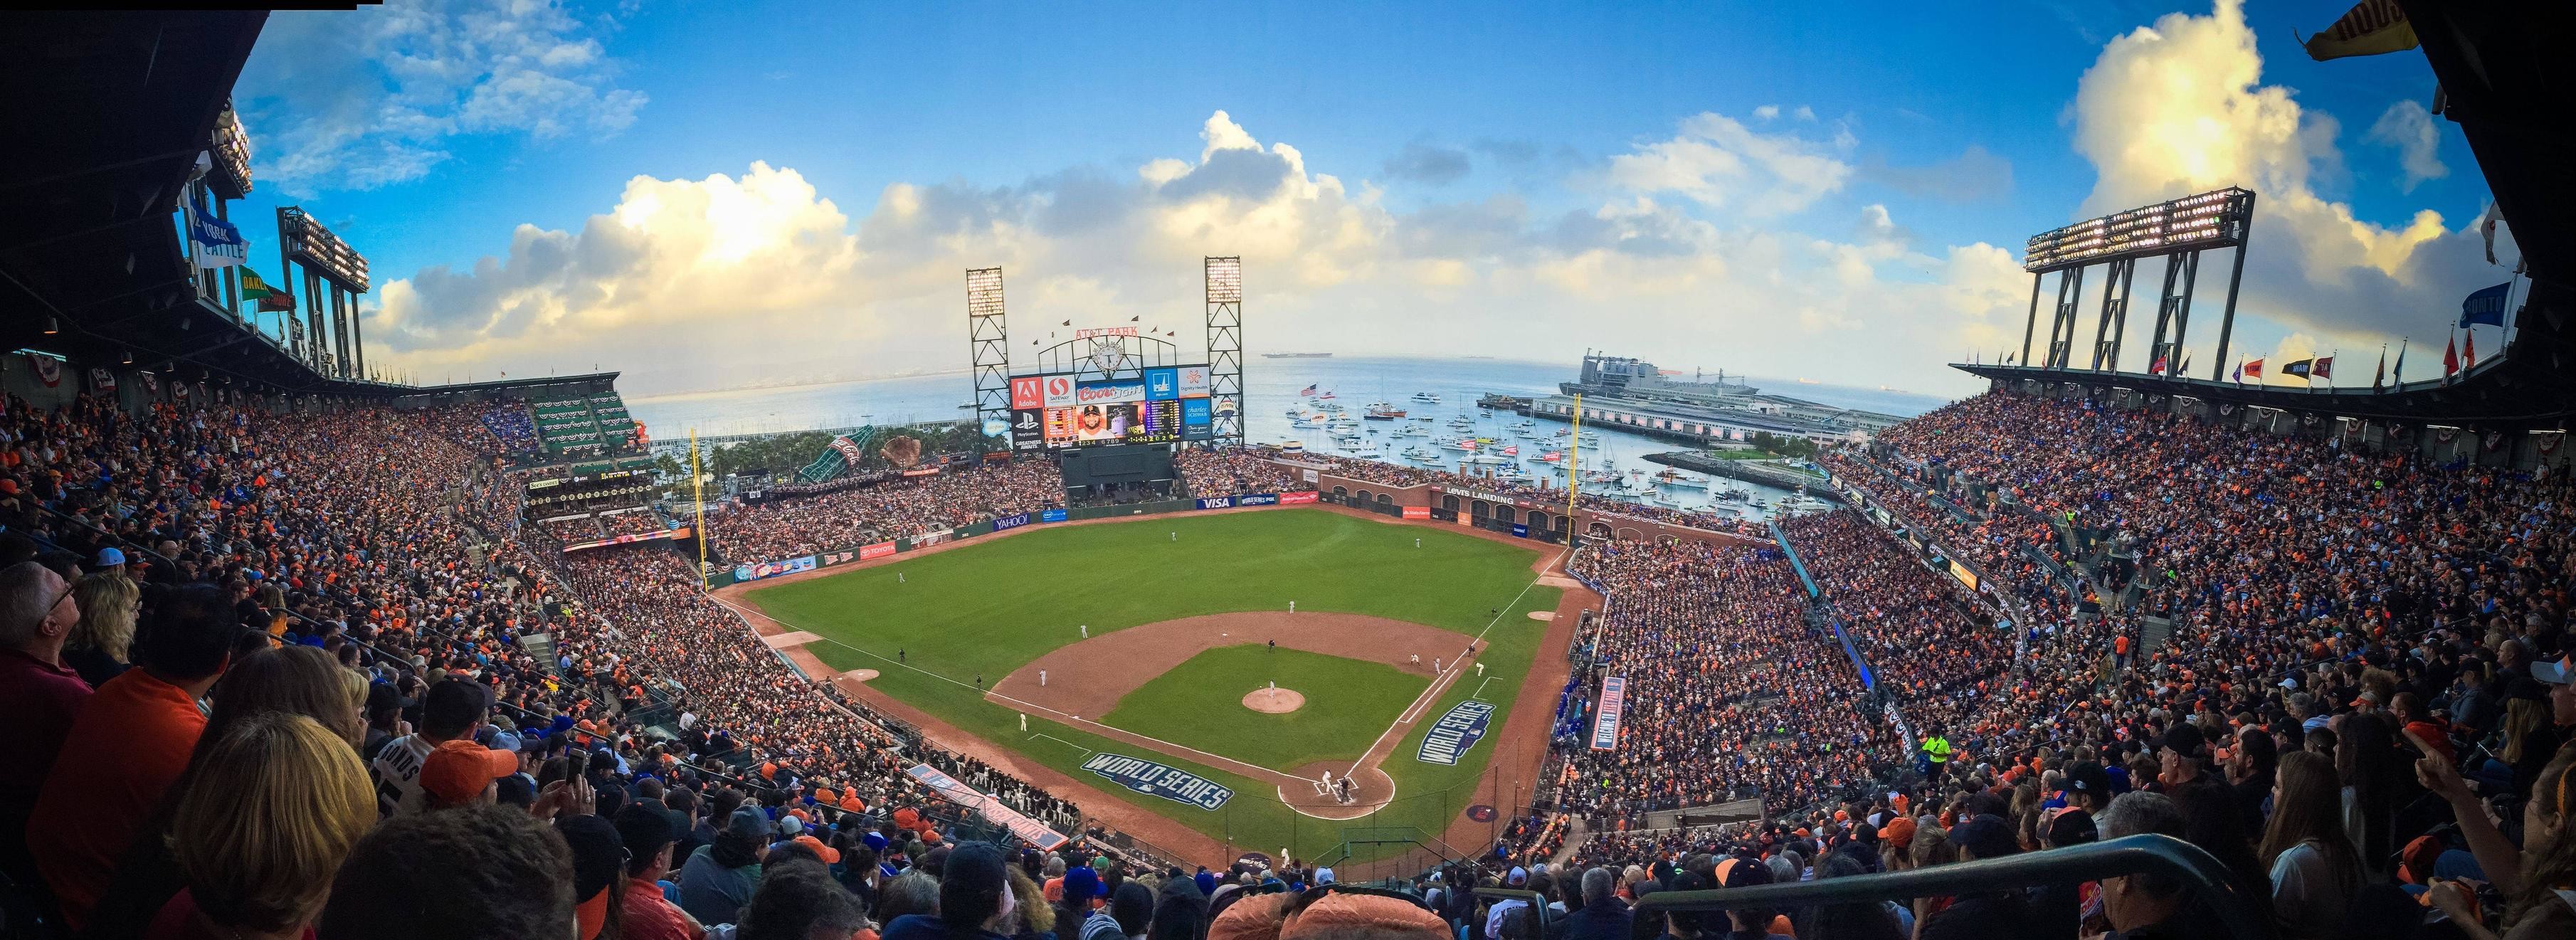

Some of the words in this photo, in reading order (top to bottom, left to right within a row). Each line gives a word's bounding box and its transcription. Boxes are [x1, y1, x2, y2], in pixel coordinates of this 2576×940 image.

[202, 221, 231, 243] YORK
[1075, 328, 1102, 339] AT&T
[1107, 327, 1138, 337] PARK
[1078, 386, 1117, 402] Coors
[1203, 498, 1230, 509] VISA
[1472, 491, 1514, 505] LANDING
[996, 514, 1028, 530] YAHOO!
[870, 545, 895, 554] TOYOTA
[1420, 731, 1463, 764] WORLD
[1447, 702, 1494, 732] SERIES
[380, 744, 420, 782] BONDS
[1087, 754, 1167, 782] WORLD
[1156, 770, 1229, 809] SERIES
